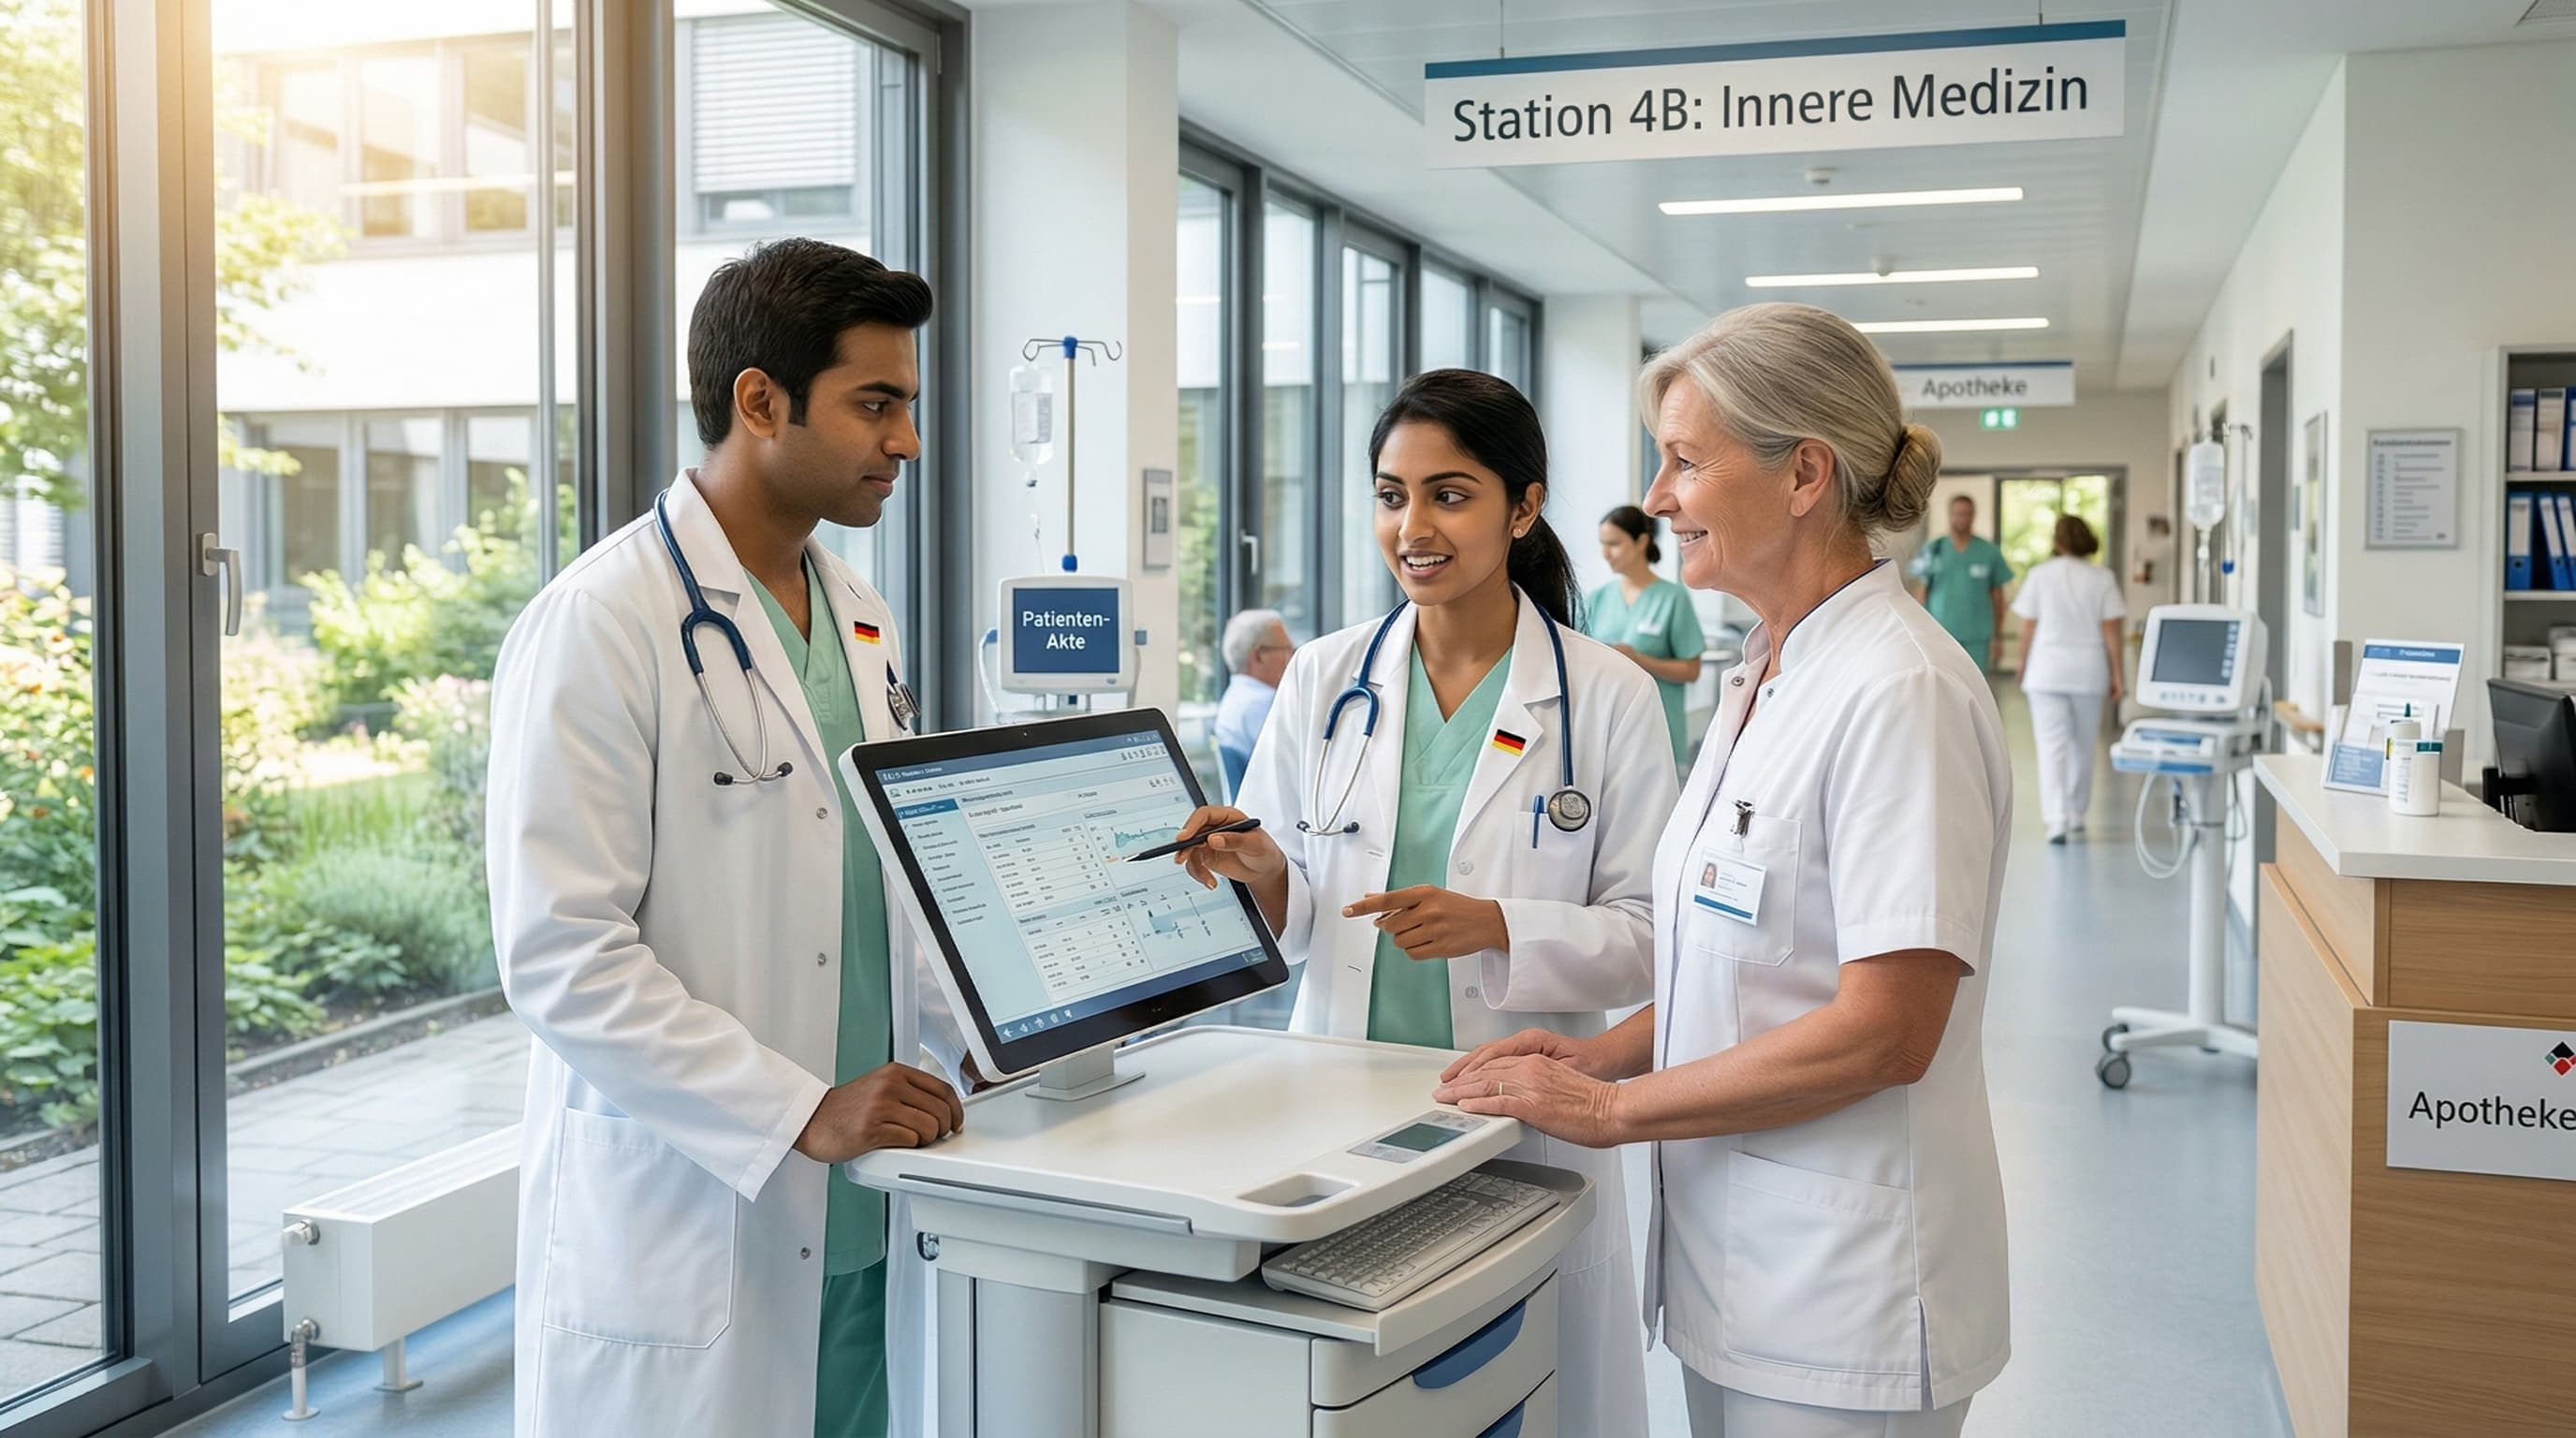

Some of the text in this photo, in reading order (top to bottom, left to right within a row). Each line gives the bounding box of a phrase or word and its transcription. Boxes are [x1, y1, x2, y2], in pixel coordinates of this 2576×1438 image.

[1453, 66, 2088, 142] Station 4B: Innere Medizin
[1922, 375, 2028, 402] Apotheke
[1022, 610, 1110, 627] Patienten-
[1046, 633, 1086, 650] Akte
[2408, 1091, 2576, 1131] Apotheke
